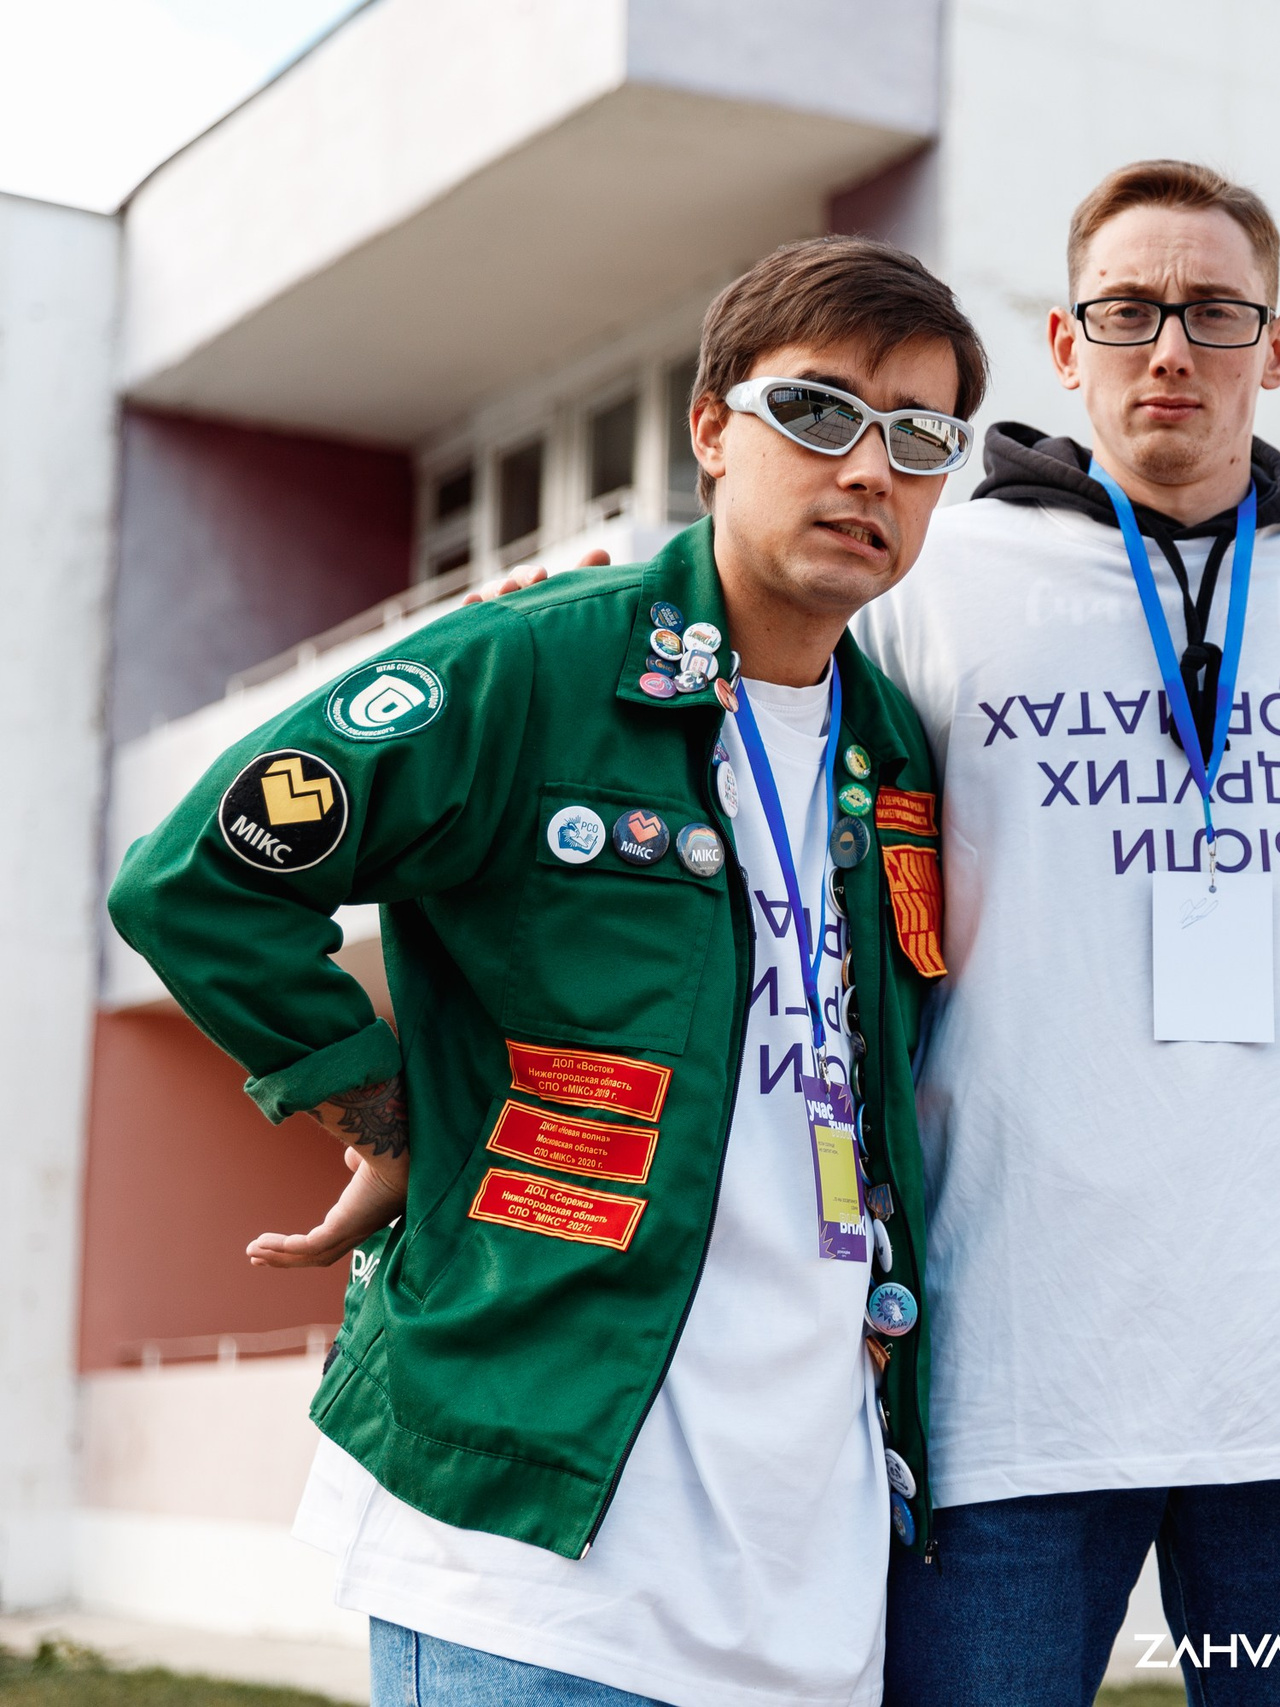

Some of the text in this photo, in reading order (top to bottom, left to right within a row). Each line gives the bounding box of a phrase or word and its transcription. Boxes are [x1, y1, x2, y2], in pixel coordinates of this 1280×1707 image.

[581, 821, 599, 834] РСО
[552, 1058, 615, 1074] ДОЛ «Восток»
[528, 1067, 633, 1091] Нижегородская область
[538, 1081, 560, 1092] СПО
[806, 1099, 835, 1122] учас
[536, 1133, 608, 1156] Московская область
[581, 1130, 611, 1142] волна»
[533, 1146, 549, 1158] СПО
[578, 1157, 596, 1168] 2020
[501, 1191, 608, 1224] Нижегородская область
[524, 1183, 594, 1210] ДОЦ «Сережа»
[508, 1204, 529, 1218] СПО
